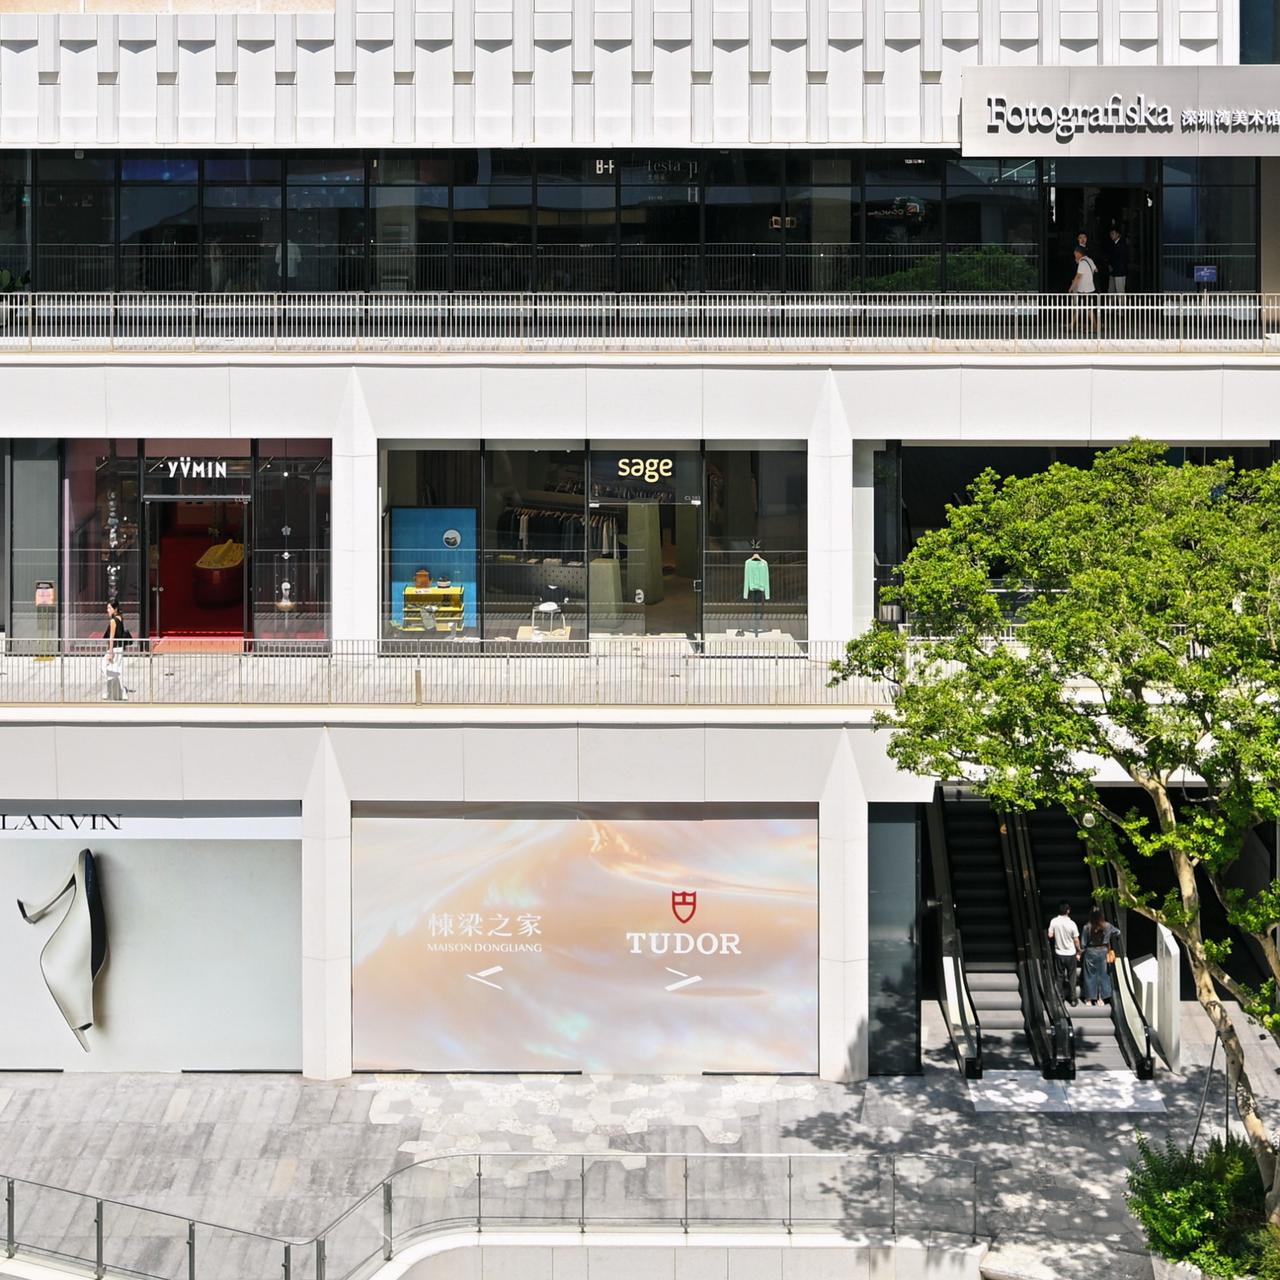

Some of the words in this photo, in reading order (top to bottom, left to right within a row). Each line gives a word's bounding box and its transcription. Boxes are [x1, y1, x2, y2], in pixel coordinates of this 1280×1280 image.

[987, 93, 1175, 136] Fotografiska
[618, 458, 673, 483] sage
[0, 813, 123, 831] LANVIN
[426, 943, 472, 953] MAISON
[474, 943, 543, 953] DONGLIANG
[626, 932, 742, 955] TUDOR
